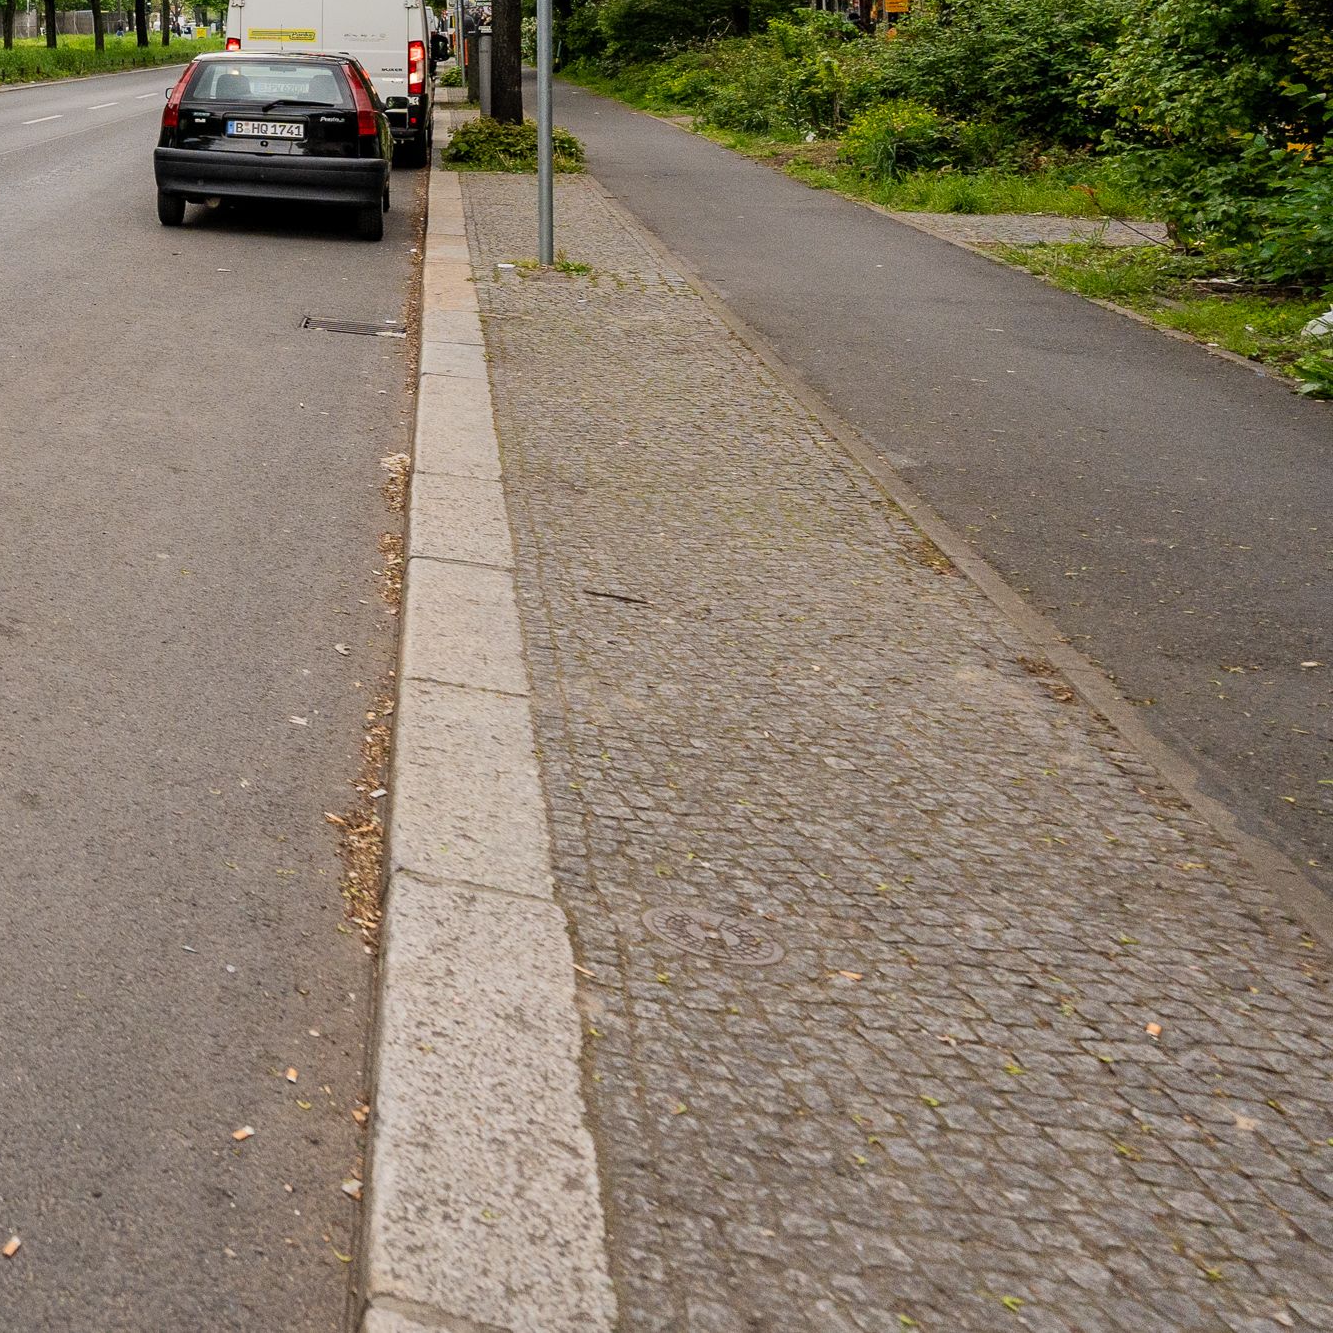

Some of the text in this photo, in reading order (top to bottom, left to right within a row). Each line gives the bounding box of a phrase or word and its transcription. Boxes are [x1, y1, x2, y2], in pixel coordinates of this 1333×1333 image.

[235, 122, 302, 136] B HQ 1741
